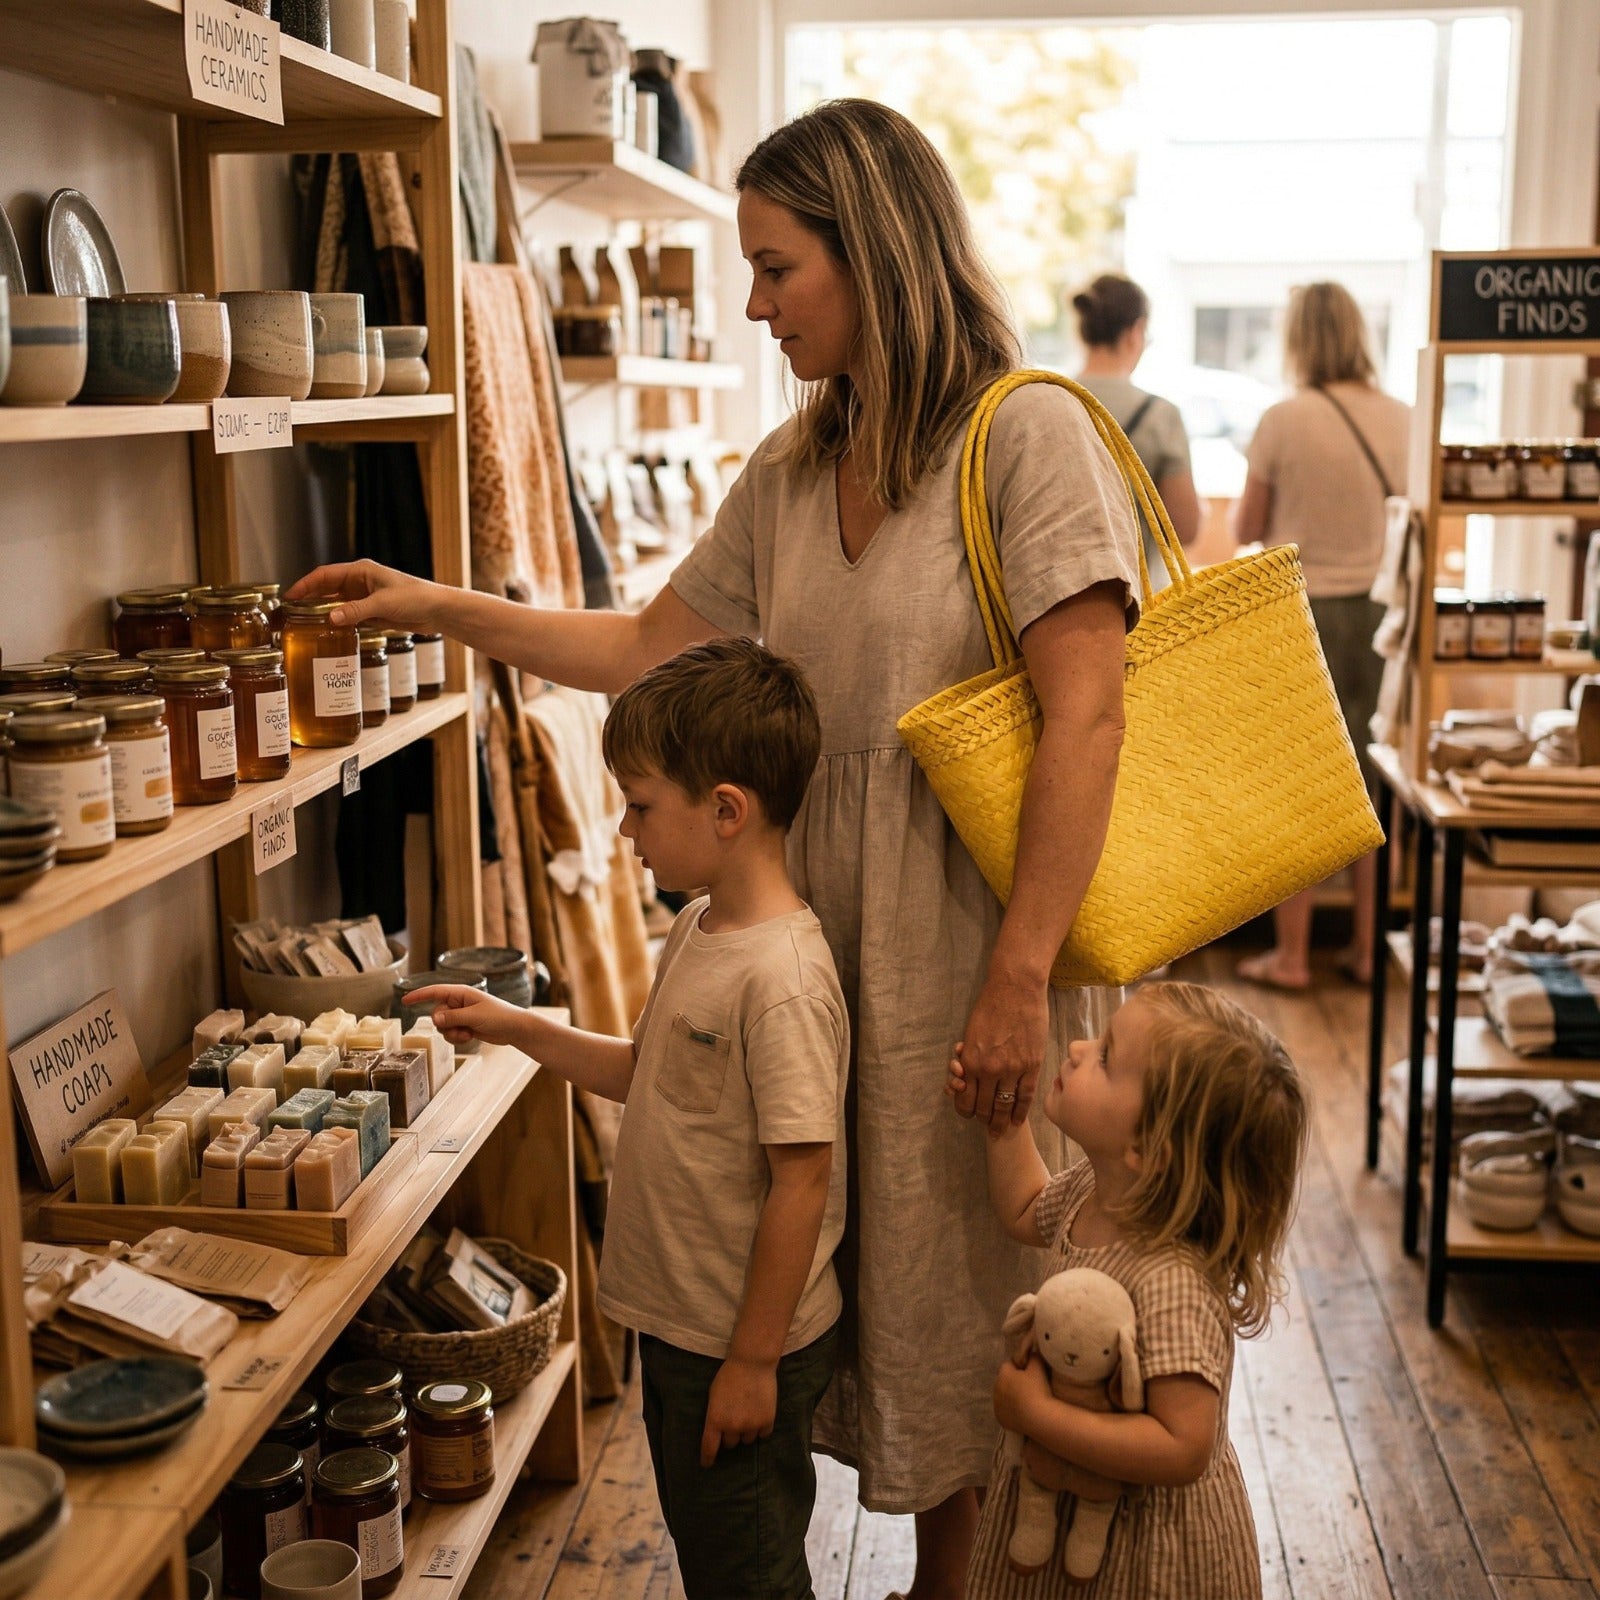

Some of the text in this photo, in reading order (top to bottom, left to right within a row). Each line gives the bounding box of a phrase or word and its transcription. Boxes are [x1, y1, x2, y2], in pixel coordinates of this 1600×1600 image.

[196, 10, 269, 66] HANDMADE
[201, 55, 267, 103] CERAMICS
[1474, 265, 1600, 299] ORGANIC
[1497, 301, 1588, 334] FINDS
[257, 807, 290, 839] ORGANIC
[263, 831, 286, 859] FINDS
[29, 1009, 118, 1089] HANDMADE
